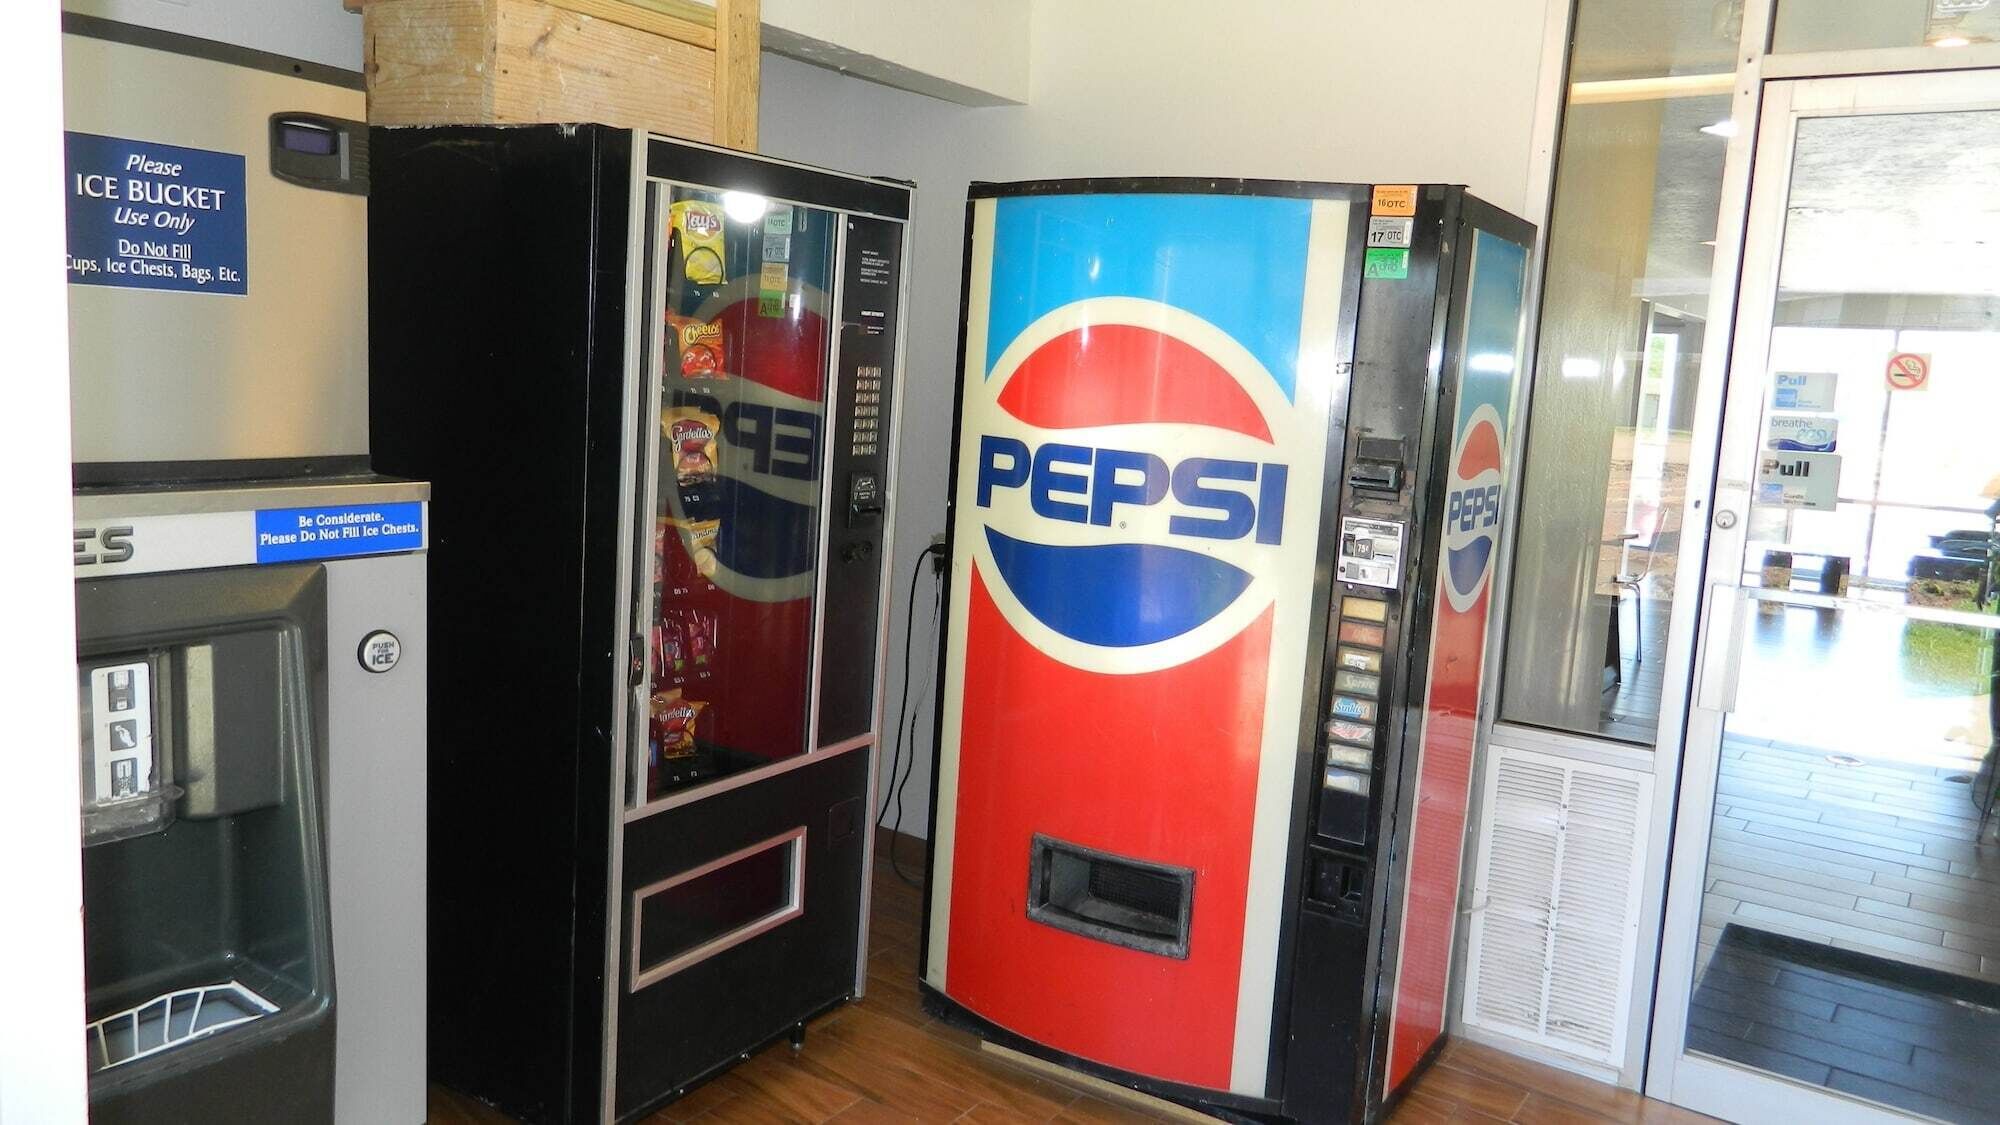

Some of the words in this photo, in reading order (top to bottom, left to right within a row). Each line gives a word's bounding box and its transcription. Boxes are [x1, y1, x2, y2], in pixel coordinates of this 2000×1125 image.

[126, 154, 183, 177] Please
[76, 173, 120, 199] ICE
[128, 179, 226, 211] BUCKET
[114, 207, 149, 226] Use
[154, 211, 196, 236] Only
[1371, 231, 1384, 243] 17
[1387, 231, 1402, 240] OTC
[118, 239, 141, 256] Do
[144, 241, 169, 258] Not
[172, 244, 191, 260] Fill
[107, 258, 127, 274] Ice
[130, 260, 178, 278] Chests,
[182, 264, 215, 284] Bags,
[219, 267, 241, 282] Etc.
[683, 323, 720, 345] Cheetos
[1777, 374, 1807, 386] Pull
[1771, 416, 1813, 428] breathe
[1762, 459, 1810, 478] Pull
[976, 434, 1289, 547] PEPSI
[298, 515, 313, 528] Be
[316, 512, 385, 526] Considerate.
[1447, 484, 1502, 536] PEPSI
[260, 533, 297, 546] Please
[300, 530, 317, 542] Do
[319, 528, 340, 541] Not
[342, 527, 360, 538] Fill
[363, 525, 379, 537] Ice
[381, 523, 419, 535] Chests.
[372, 653, 394, 665] ICE
